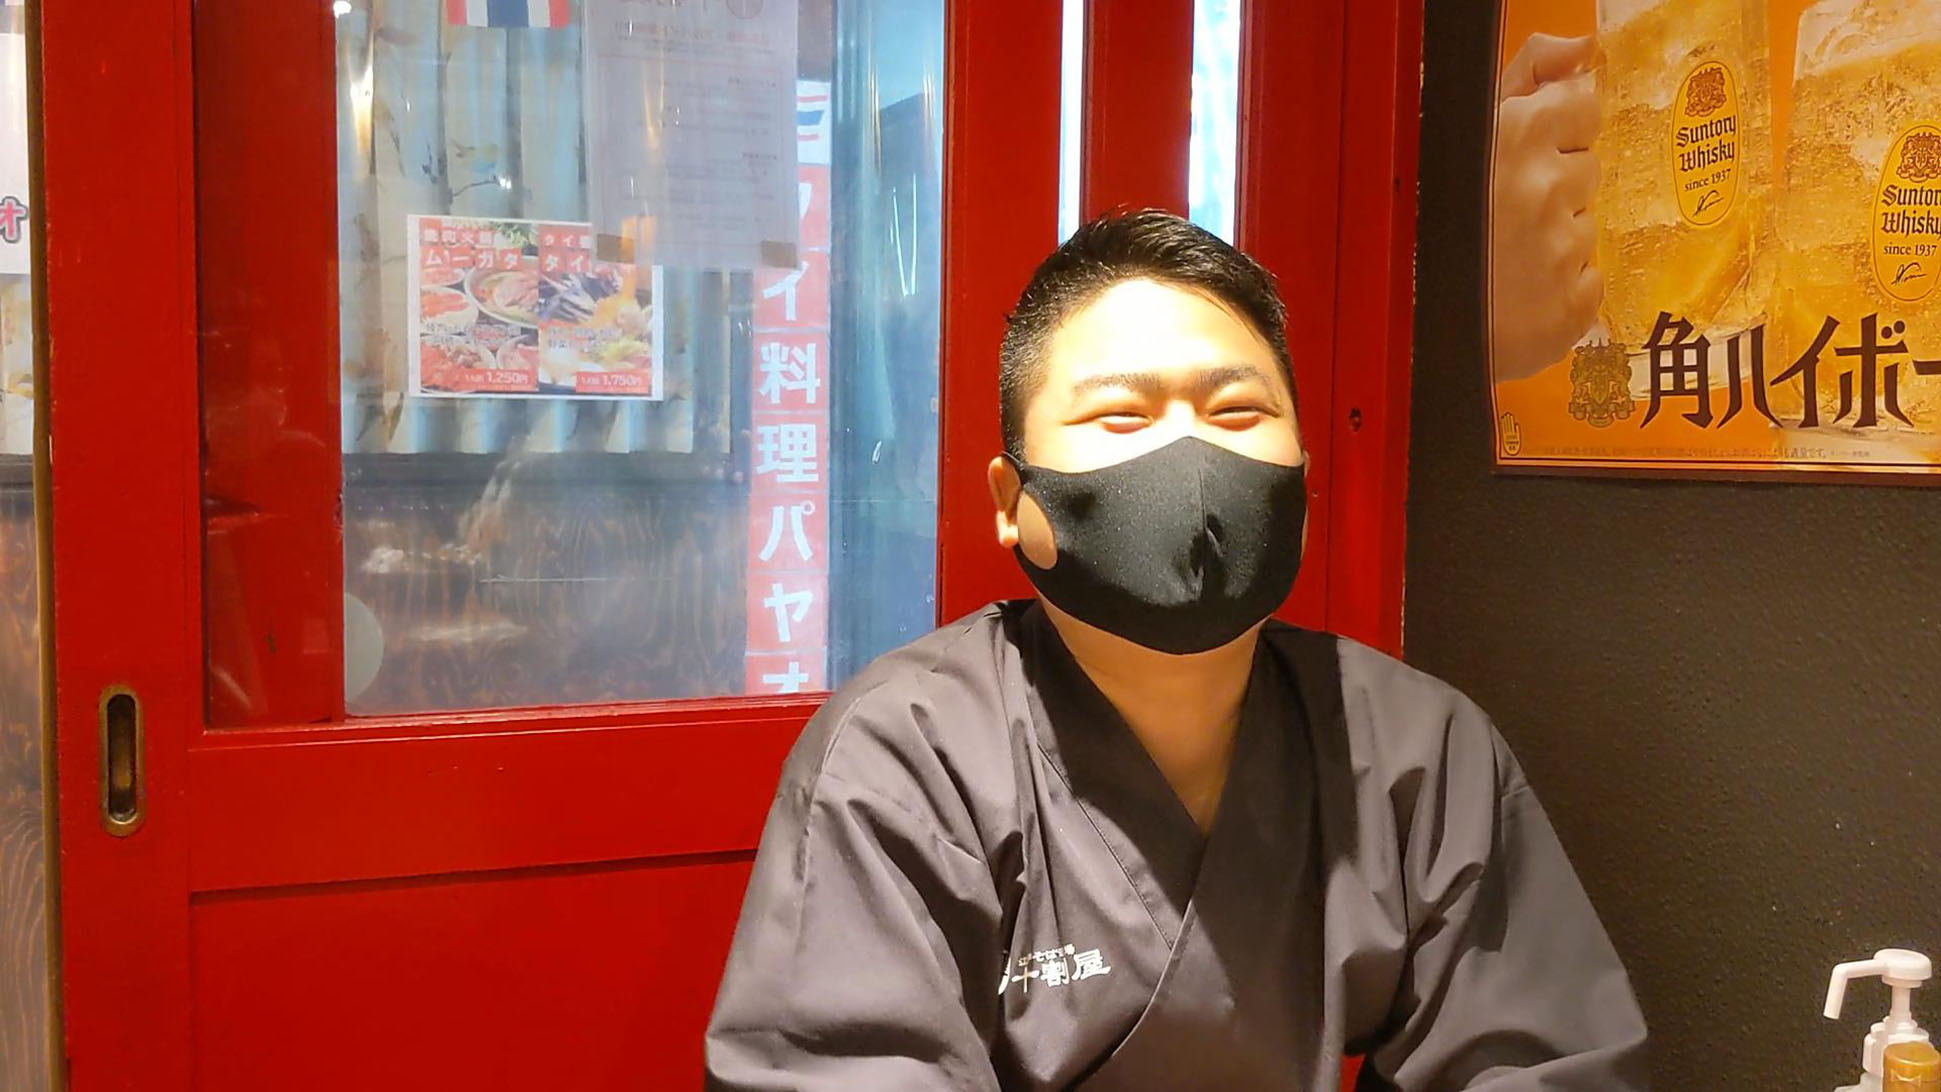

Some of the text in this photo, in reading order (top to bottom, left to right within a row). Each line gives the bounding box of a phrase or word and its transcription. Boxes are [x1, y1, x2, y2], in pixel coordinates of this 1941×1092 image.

[1675, 115, 1737, 147] Suntory
[1679, 139, 1735, 173] Whisky
[1684, 168, 1732, 191] since 1937
[1881, 184, 1941, 207] Suntor
[1883, 242, 1938, 257] since 1937
[757, 182, 820, 693] イ料理パヤオ
